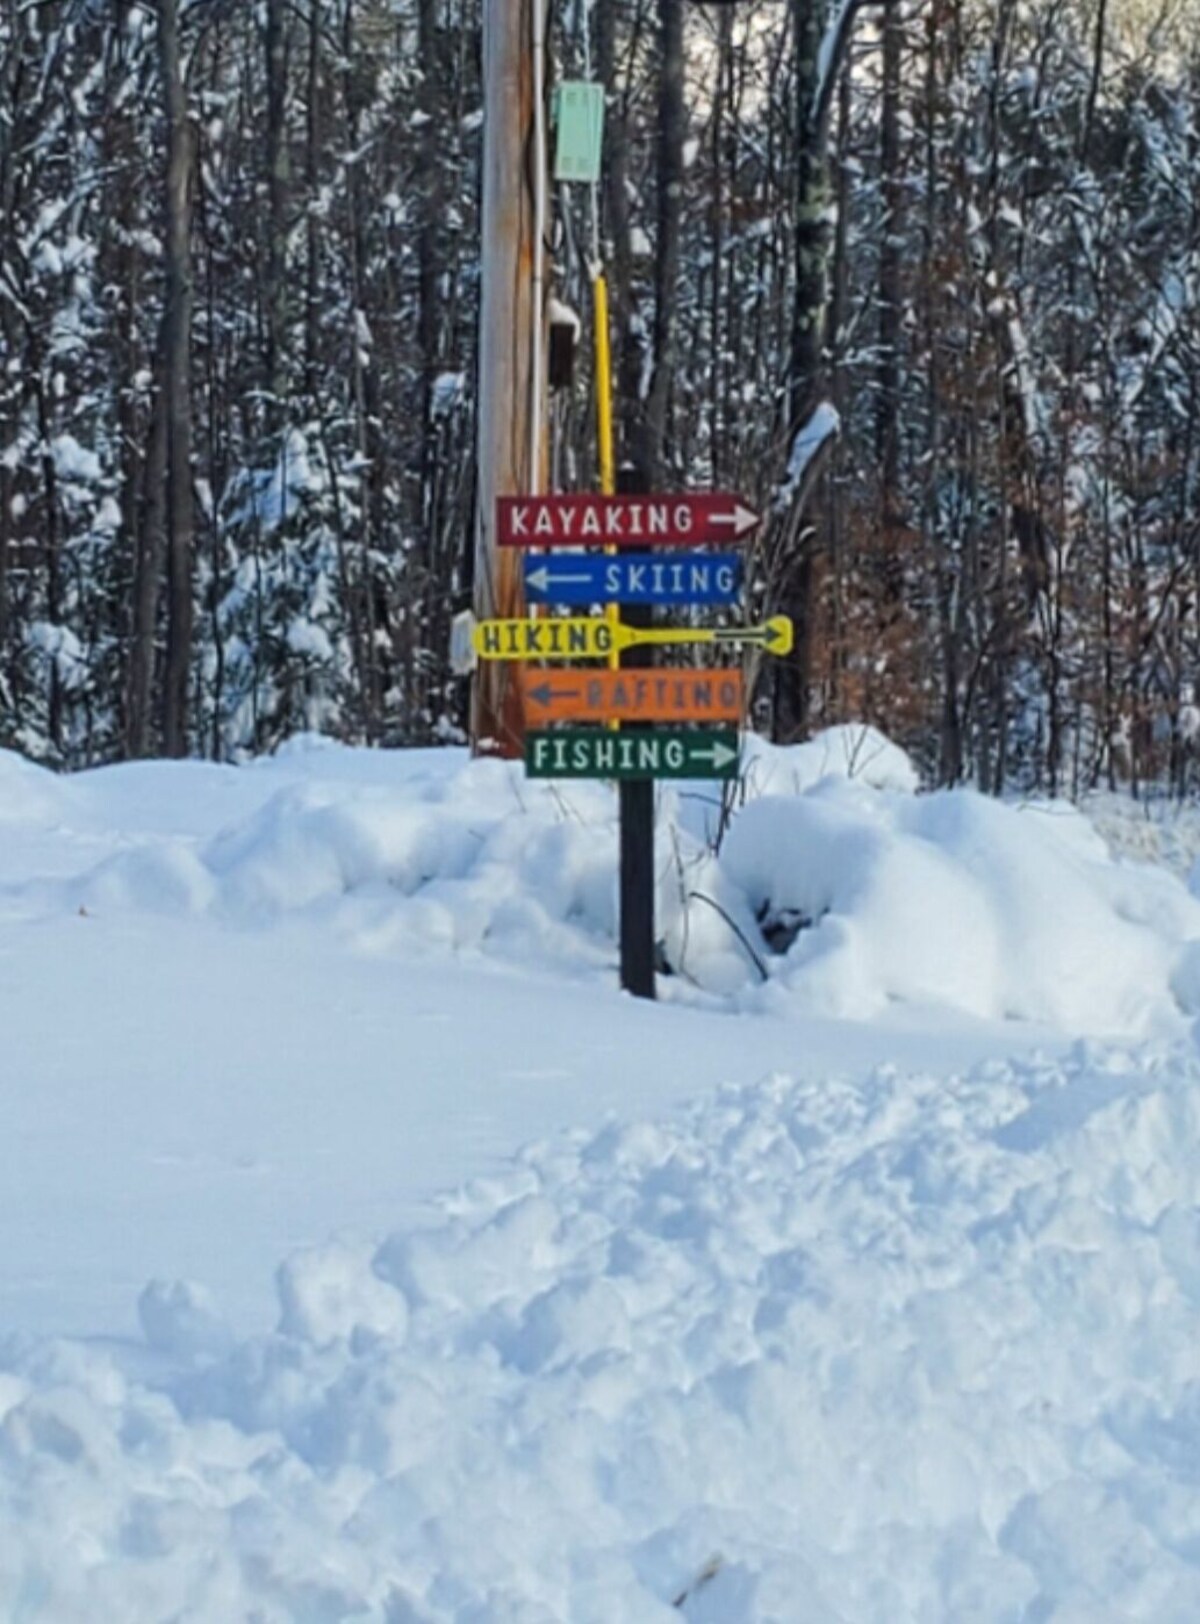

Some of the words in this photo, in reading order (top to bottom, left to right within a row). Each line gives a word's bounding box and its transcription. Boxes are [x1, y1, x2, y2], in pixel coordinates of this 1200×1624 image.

[511, 505, 692, 535] KAYAKING
[605, 564, 733, 592] SKIING
[482, 624, 612, 653] HIKING
[534, 739, 684, 769] FISHING
